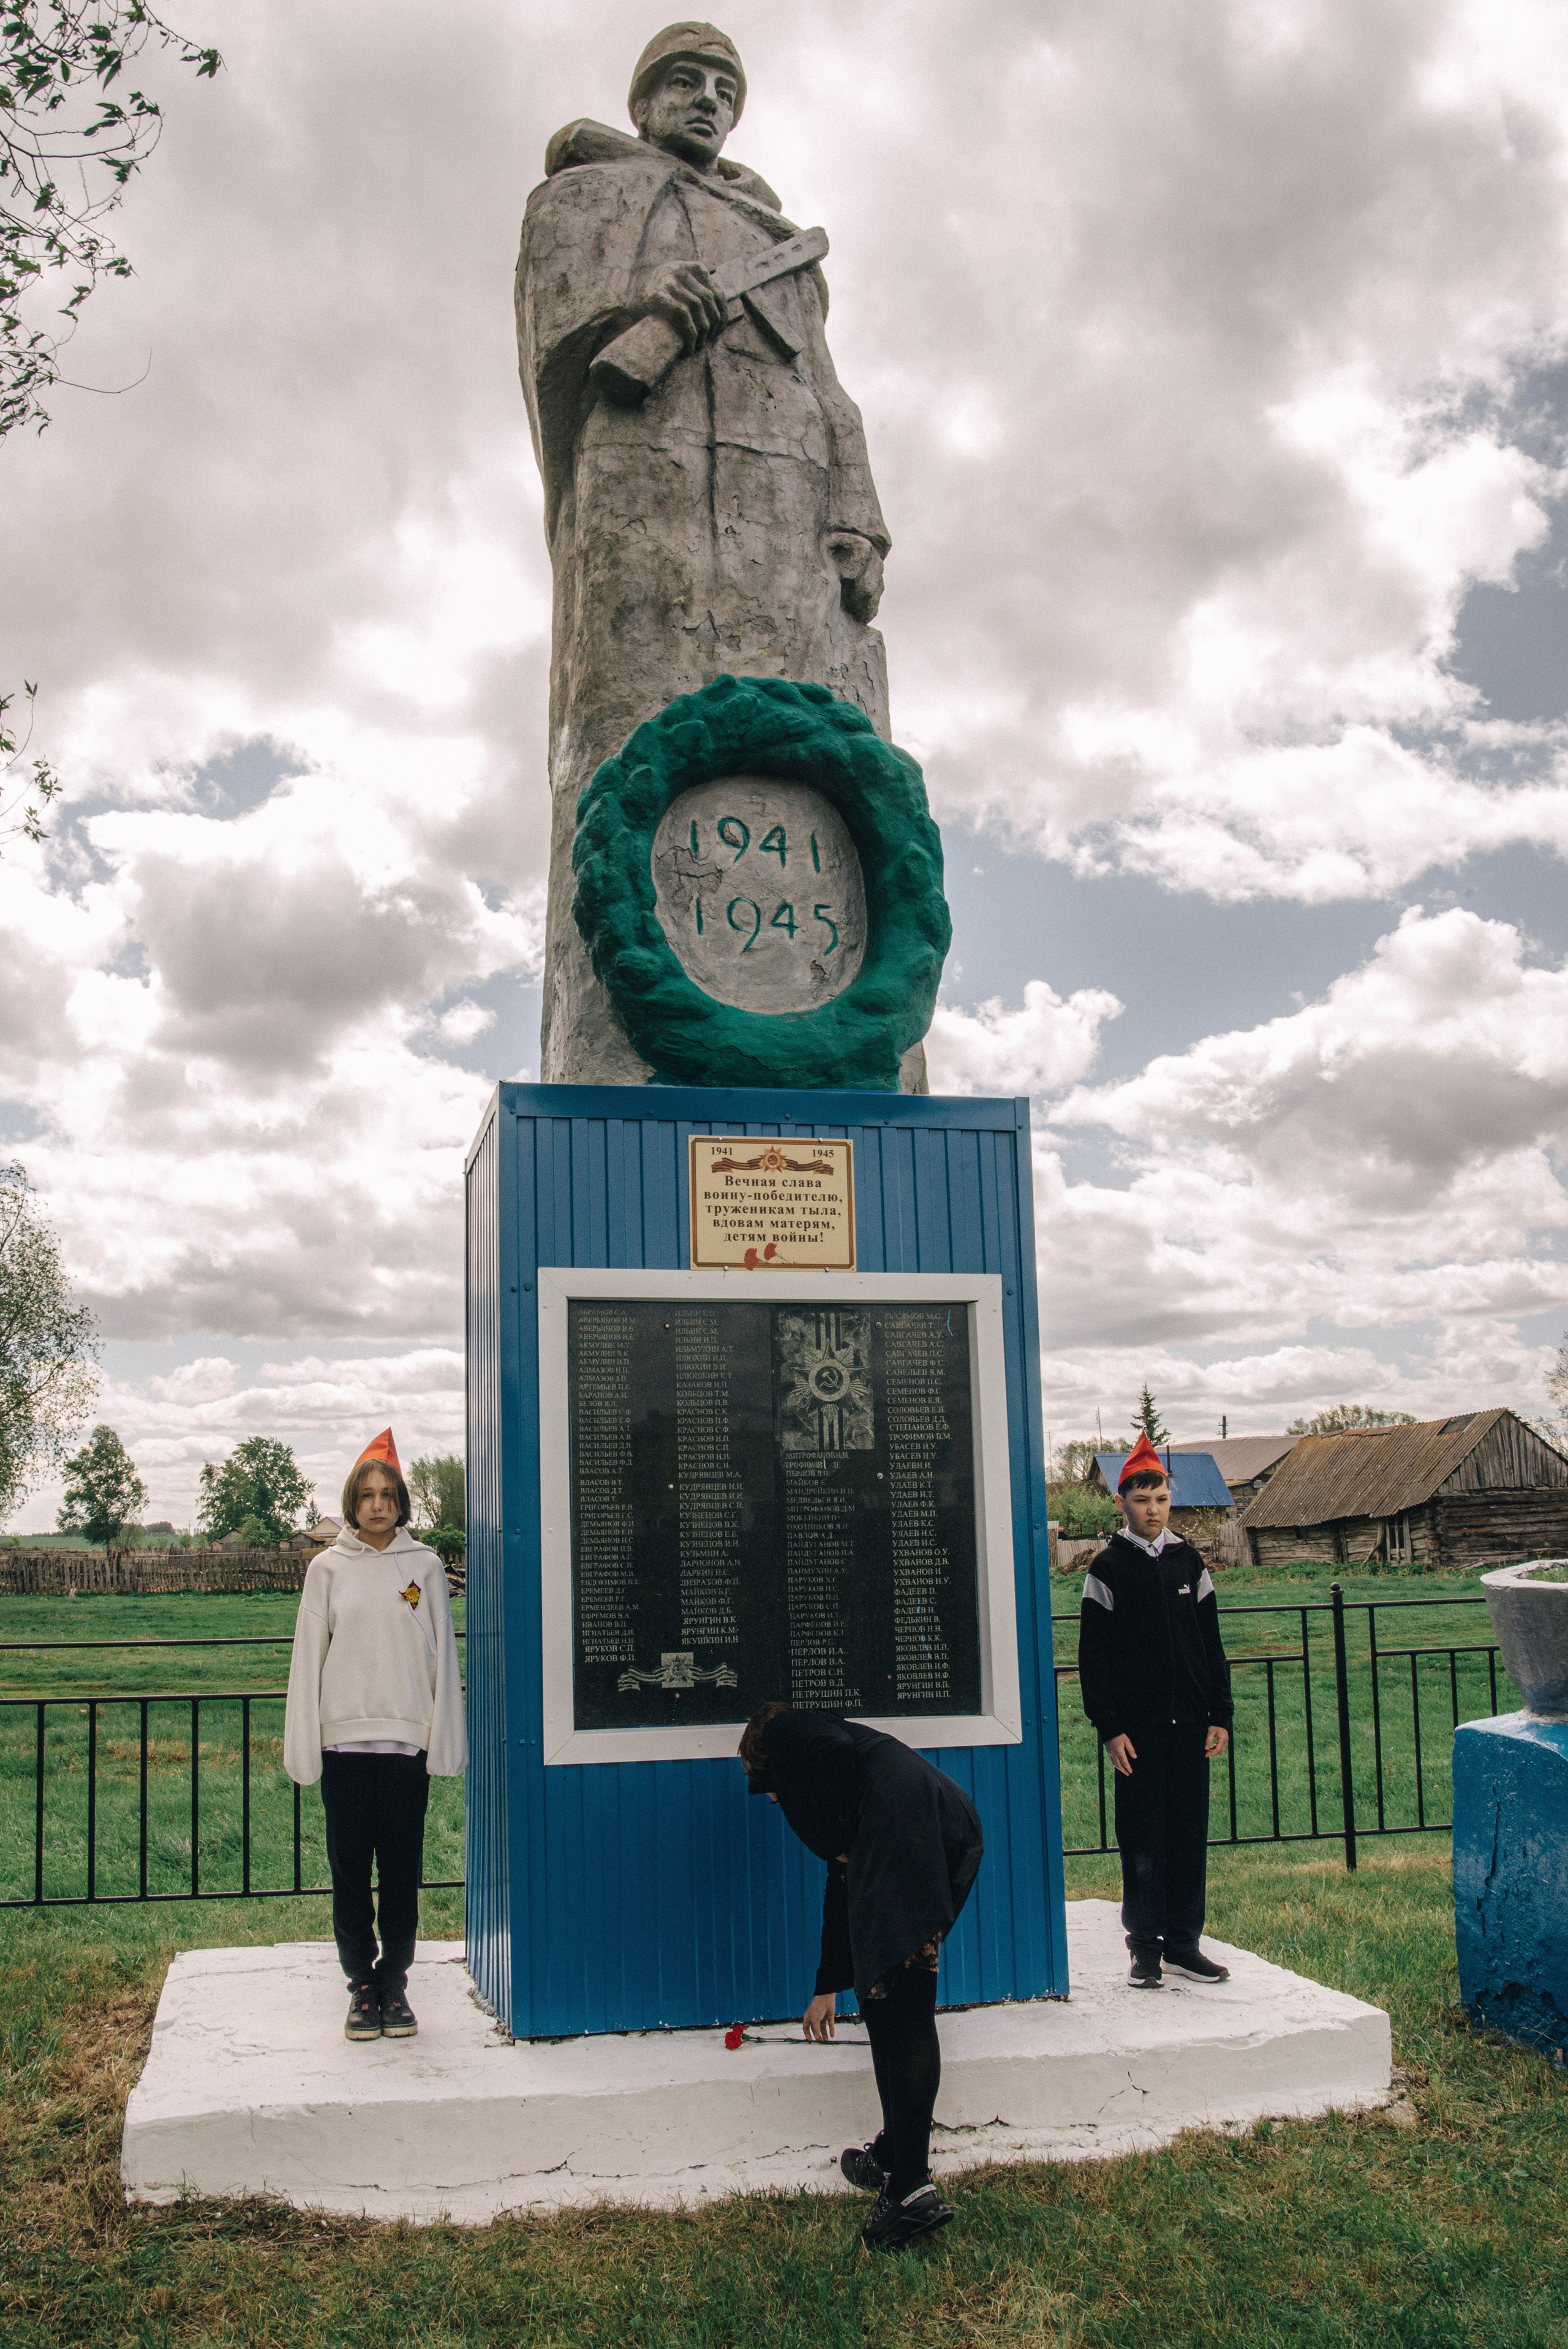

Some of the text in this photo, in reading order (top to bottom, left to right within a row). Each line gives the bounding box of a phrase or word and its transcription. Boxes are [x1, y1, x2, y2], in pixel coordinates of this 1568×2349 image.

[690, 816, 821, 873] 1941
[695, 896, 839, 957] 1945
[711, 1147, 733, 1155] 1941
[812, 1149, 834, 1158] 1945
[725, 1175, 821, 1187] Вечная слава
[704, 1190, 843, 1203] воину-победителю,
[706, 1204, 841, 1218] труженикам тыла,
[713, 1218, 835, 1232] вдовам матерям,
[724, 1231, 824, 1242] детям войны!
[681, 1597, 716, 1605] МАЙКОВ
[681, 1626, 718, 1635] ЯРУНГИН
[793, 1690, 842, 1699] ПЕТРУШИН
[793, 1700, 842, 1709] ПЕТРУШИН
